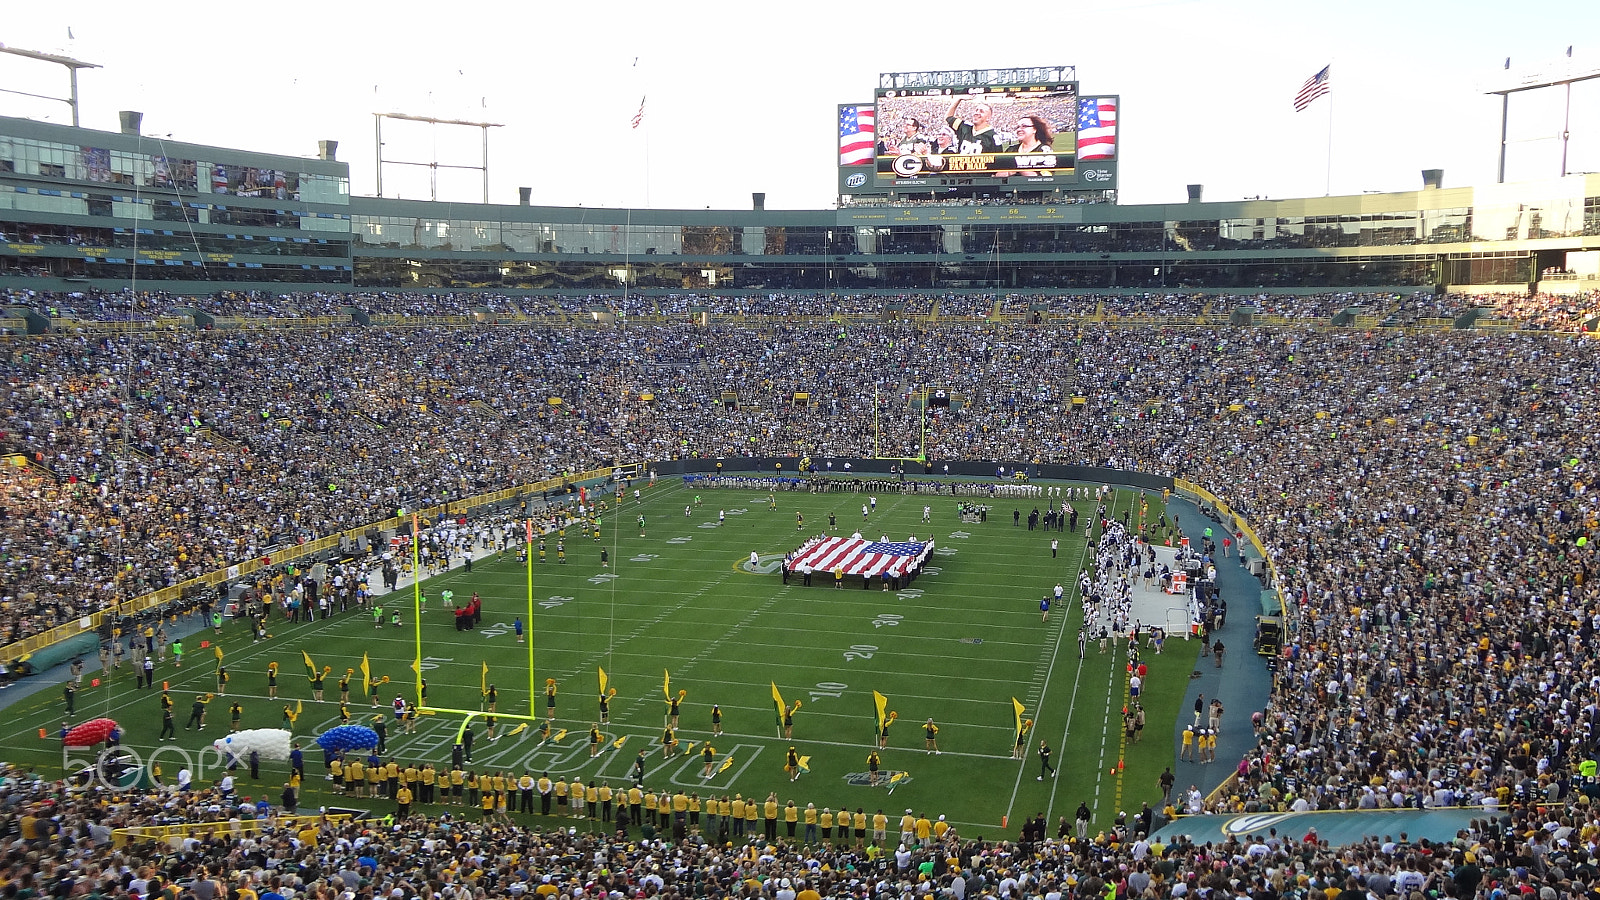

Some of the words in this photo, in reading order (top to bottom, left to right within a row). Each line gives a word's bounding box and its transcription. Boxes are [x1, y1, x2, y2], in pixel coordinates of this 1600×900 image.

[903, 69, 988, 87] LAMBEAU
[997, 68, 1049, 84] FIELD
[948, 155, 996, 164] OPERATION
[948, 163, 966, 171] FAN
[966, 162, 988, 170] MAIL
[1015, 155, 1057, 166] WPS
[935, 389, 946, 398] 25
[872, 614, 904, 628] 30
[480, 622, 516, 639] 20
[843, 644, 879, 662] 20
[809, 682, 848, 702] 10
